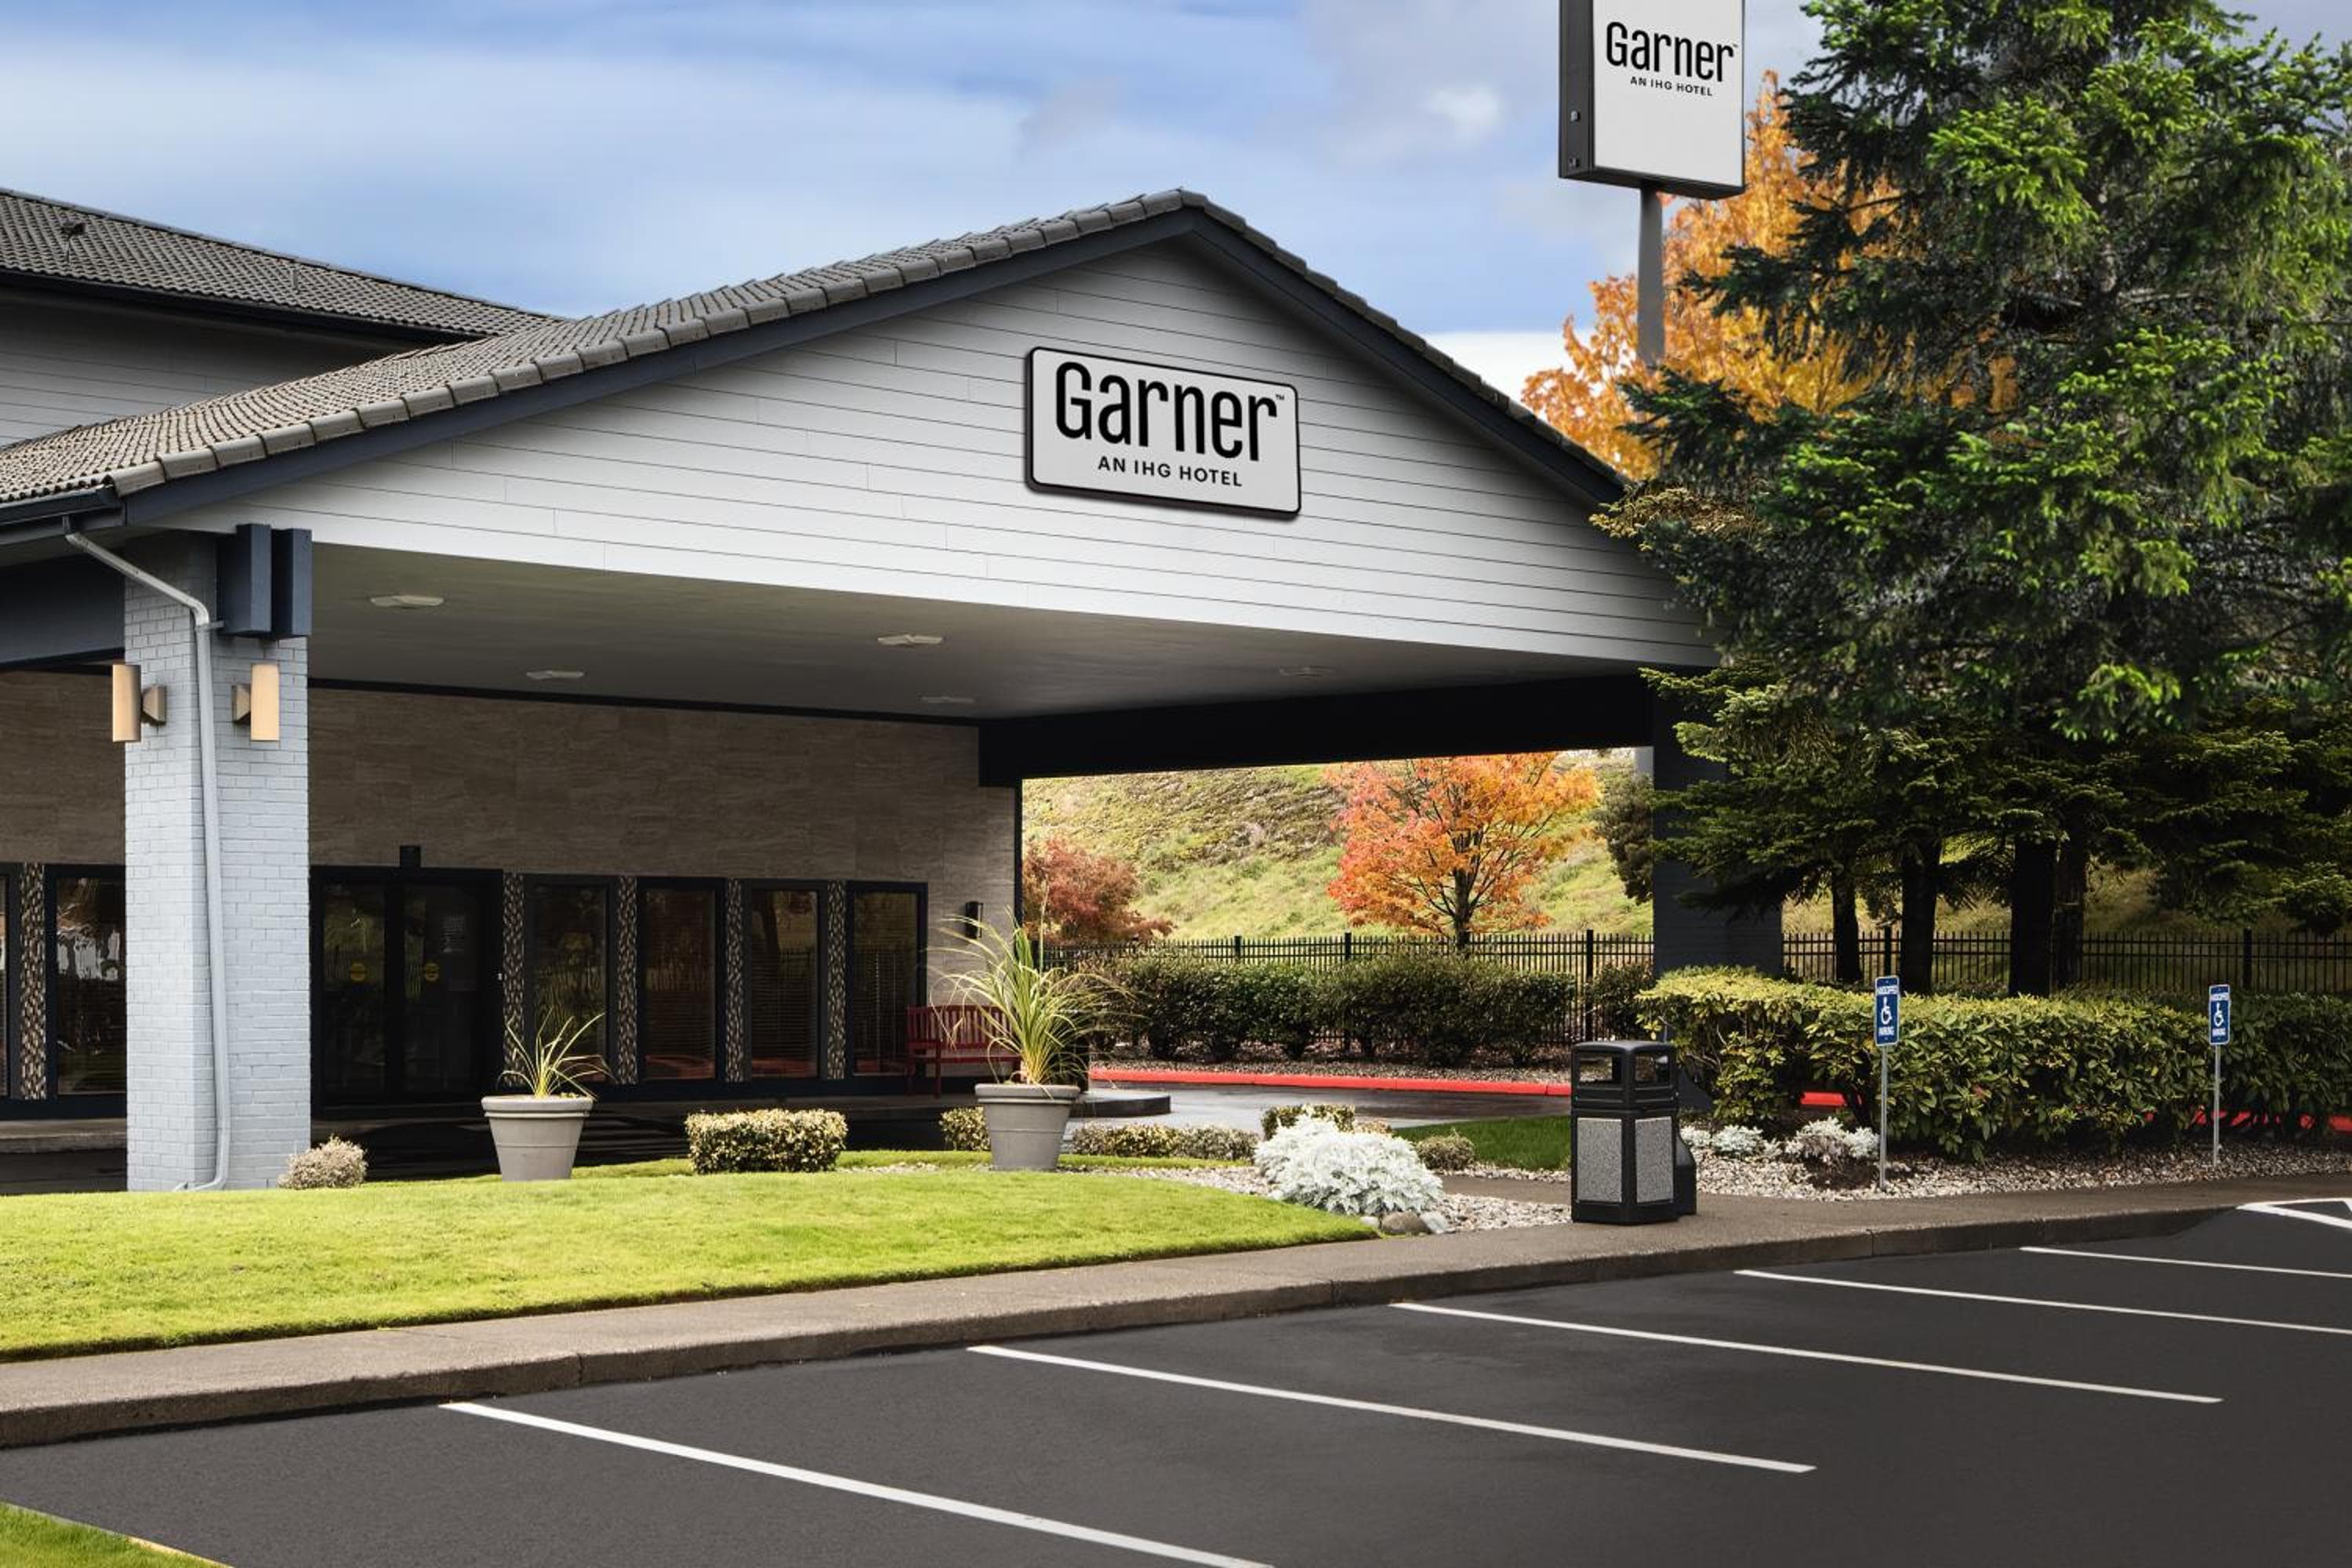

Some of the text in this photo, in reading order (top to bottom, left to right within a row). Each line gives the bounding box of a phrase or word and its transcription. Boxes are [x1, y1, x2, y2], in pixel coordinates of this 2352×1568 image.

[1630, 76, 1713, 96] AN IHG HOTEL
[1097, 456, 1243, 488] AN IHG HOTEL
